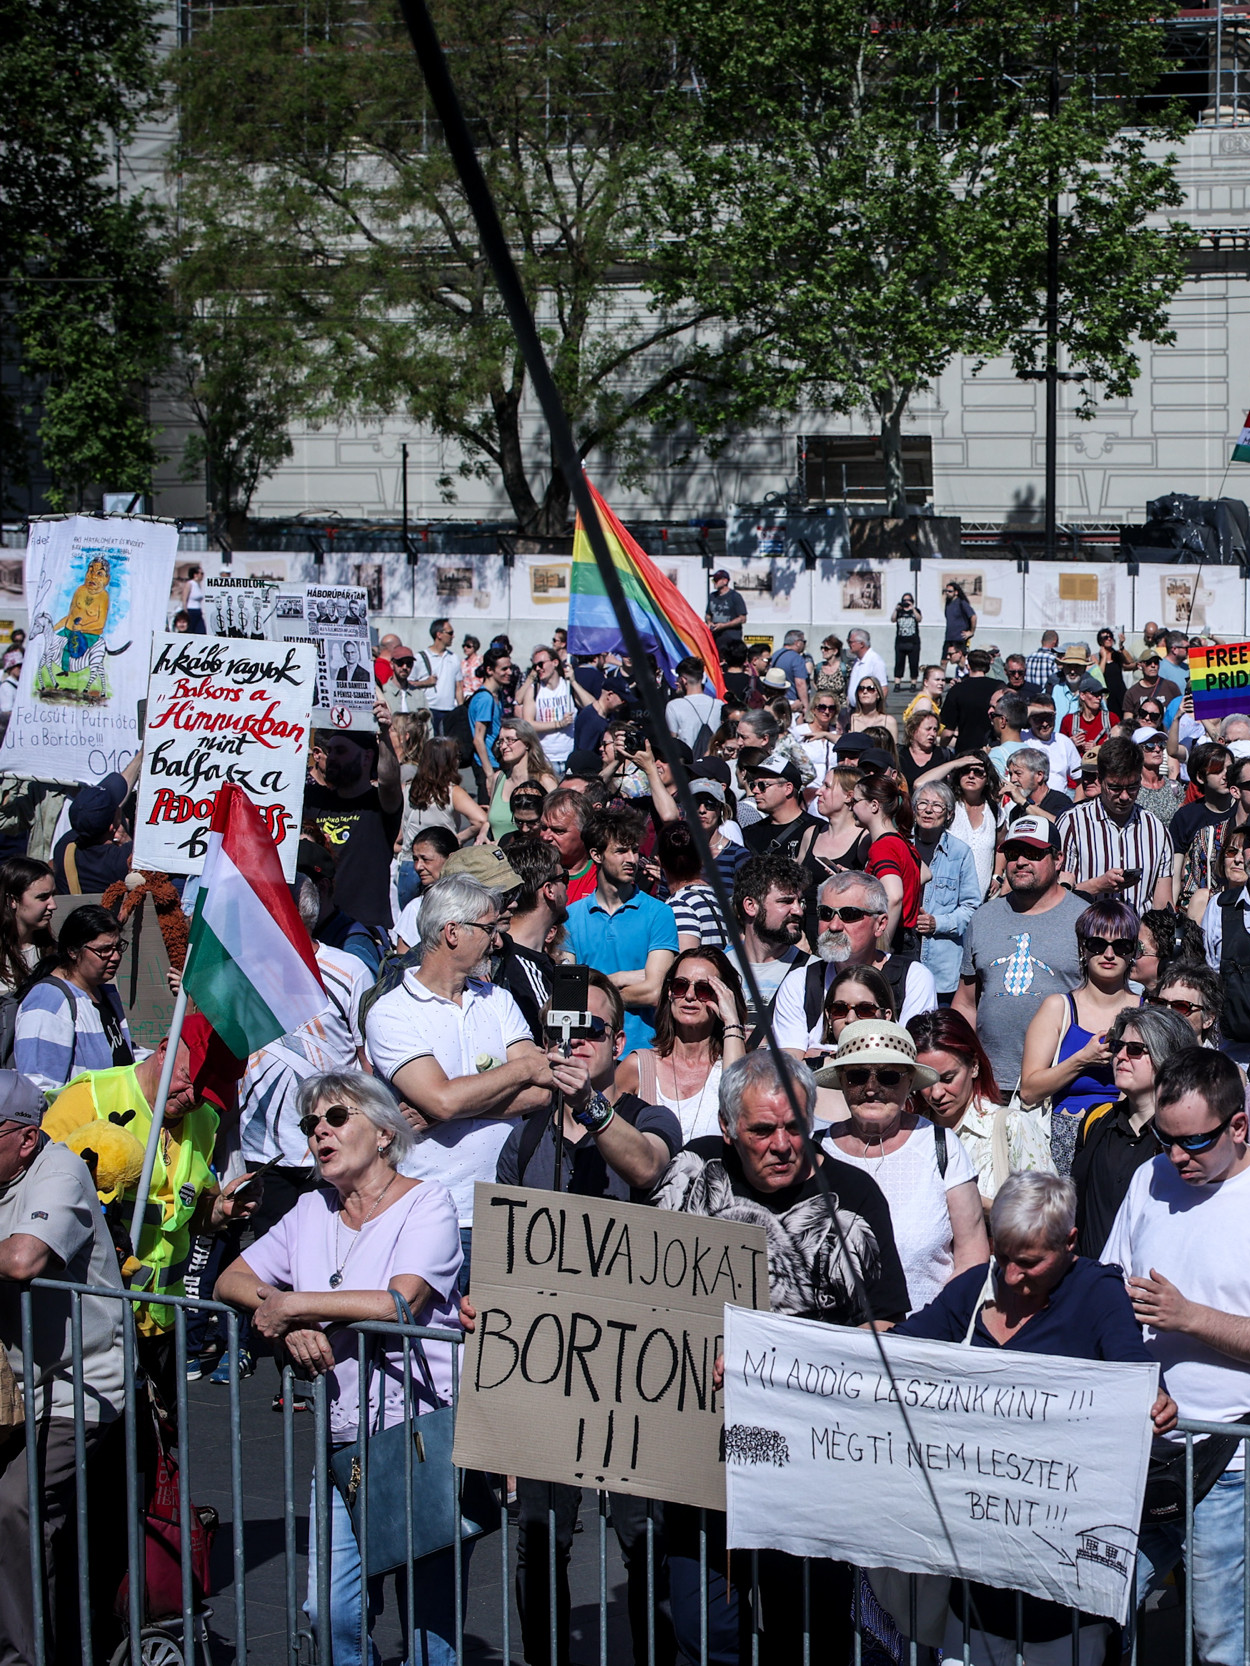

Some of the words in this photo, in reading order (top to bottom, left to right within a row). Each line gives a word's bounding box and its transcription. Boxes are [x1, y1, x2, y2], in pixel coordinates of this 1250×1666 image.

[225, 647, 304, 686] vagyok
[1206, 646, 1248, 668] FREE
[249, 690, 272, 701] a
[81, 709, 137, 730] Putrióta
[198, 733, 258, 755] mint
[148, 739, 268, 795] balfasz
[260, 771, 290, 792] a
[491, 1197, 764, 1311] TOLVAJOKAT
[744, 1347, 777, 1390] MI
[786, 1358, 864, 1400] ADDIG
[873, 1374, 986, 1413] LESZÜNK
[993, 1385, 1059, 1421] KINT
[1067, 1389, 1095, 1422] !!!
[574, 1409, 640, 1483] !!!
[907, 1441, 967, 1472] NEM
[976, 1445, 1079, 1493] LESZTEK
